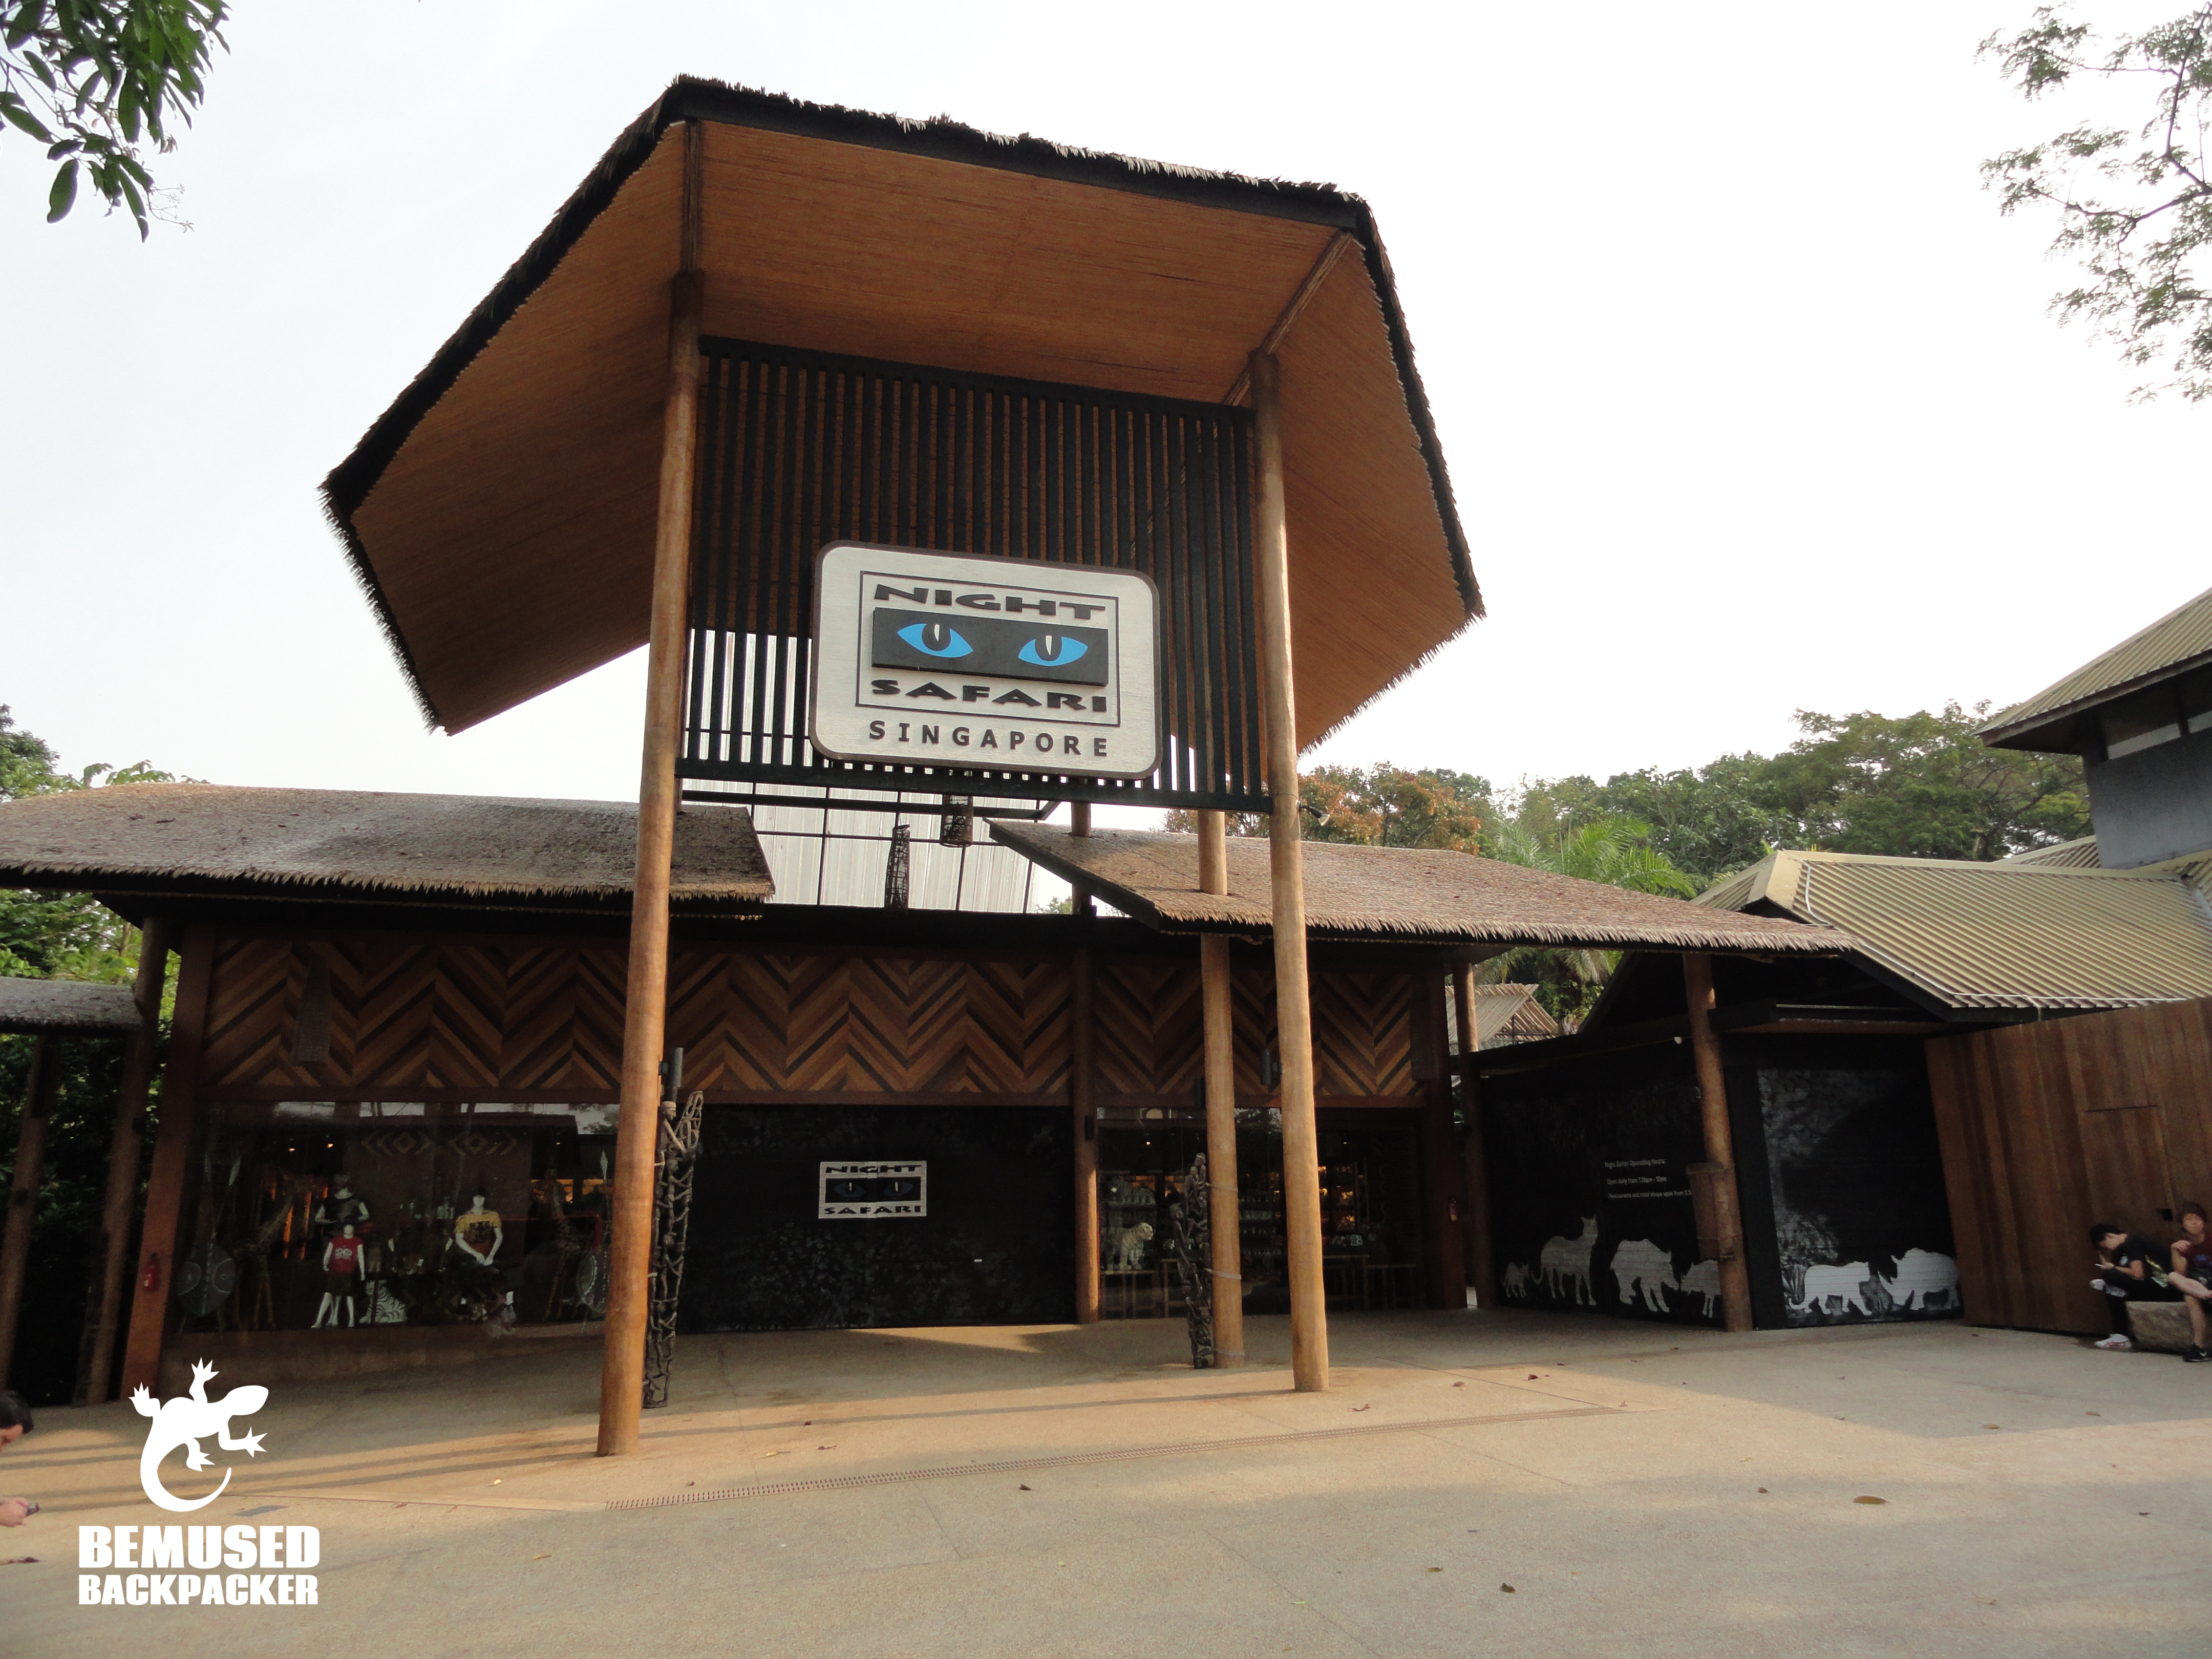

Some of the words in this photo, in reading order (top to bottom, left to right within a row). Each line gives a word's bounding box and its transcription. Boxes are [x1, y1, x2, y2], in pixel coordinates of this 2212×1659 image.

[874, 583, 1106, 620] NIGHT
[871, 678, 1107, 712] SAFARI
[869, 720, 1108, 757] SINGAPORE
[825, 1164, 922, 1174] NIGHT
[824, 1205, 921, 1215] SAFARI
